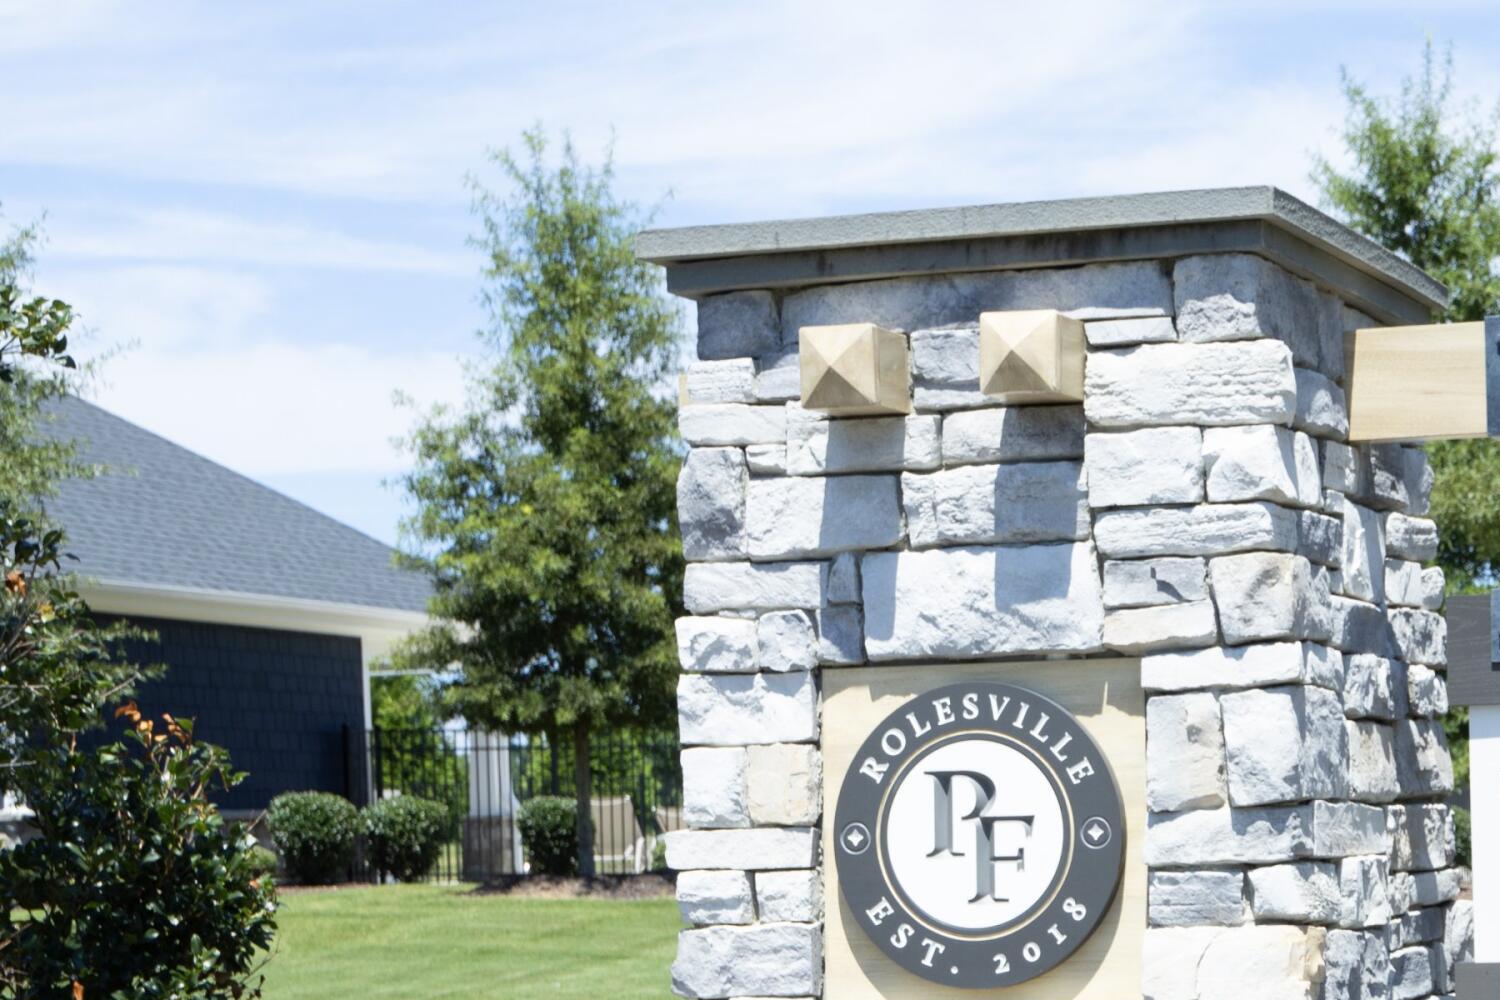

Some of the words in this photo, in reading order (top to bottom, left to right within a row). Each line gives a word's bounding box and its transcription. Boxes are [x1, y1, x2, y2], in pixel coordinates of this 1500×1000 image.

[859, 693, 1095, 785] ROLESVILLE
[865, 897, 959, 975] EST.
[993, 896, 1087, 974] 2018
